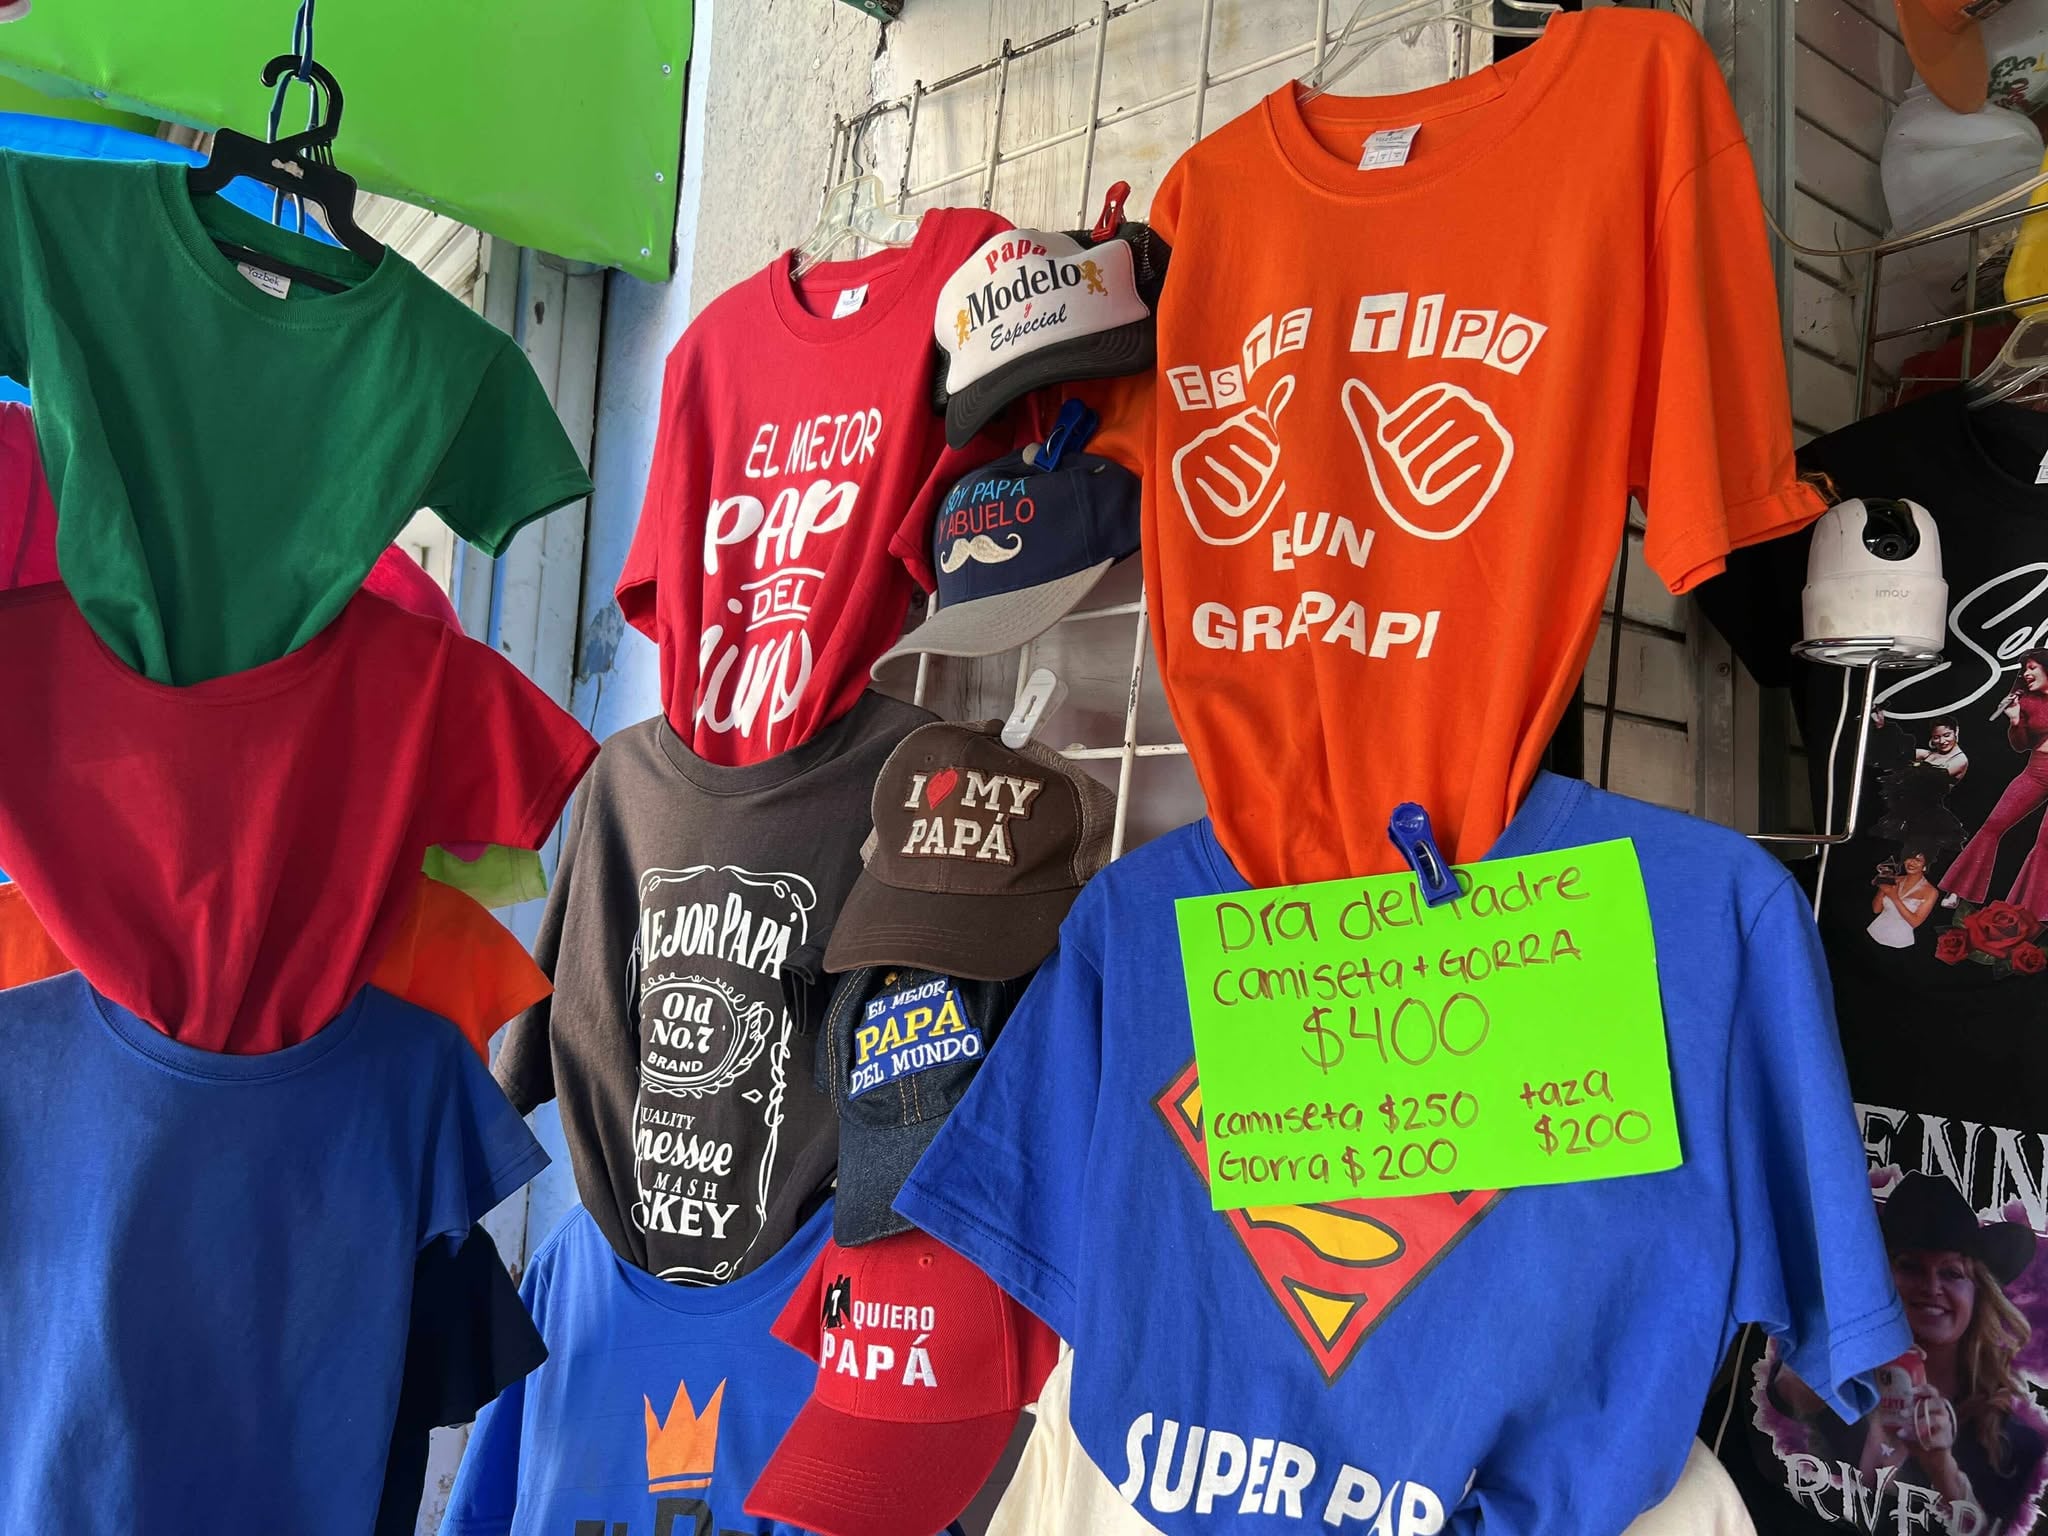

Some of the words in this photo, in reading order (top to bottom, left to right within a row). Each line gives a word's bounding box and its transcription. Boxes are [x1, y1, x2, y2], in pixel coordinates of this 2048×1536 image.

[247, 266, 280, 287] Yazbek
[966, 259, 1081, 333] Modelo
[990, 303, 1068, 351] Especial
[1023, 302, 1033, 318] y
[1166, 307, 1312, 411] ESTE
[1350, 292, 1548, 375] TIPO
[745, 423, 780, 479] EL
[785, 407, 883, 474] MEJOR
[703, 479, 860, 576] PAP
[946, 497, 1036, 540] ABUELO
[751, 578, 813, 624] DEL
[904, 774, 928, 809] I
[960, 770, 1040, 815] MY
[901, 812, 1011, 862] PAPÁ
[1338, 881, 1425, 941] del
[1438, 928, 1582, 984] GORRA
[662, 992, 714, 1025] Old
[867, 1000, 887, 1020] EL
[889, 979, 946, 1010] MEJOR
[856, 990, 967, 1066] PAPÁ
[1301, 991, 1491, 1075] $400
[647, 1051, 704, 1073] BRAND
[851, 1062, 885, 1095] DEL
[890, 1034, 979, 1077] MUNDO
[1519, 1068, 1615, 1110] taza
[640, 1106, 697, 1130] UALITY
[1213, 1101, 1364, 1139] camiseta
[1378, 1090, 1480, 1134] $250
[1533, 1108, 1652, 1156] $200
[653, 1171, 719, 1200] MASH
[1217, 1153, 1329, 1185] Gorra
[852, 1299, 936, 1331] QUIERO
[820, 1333, 938, 1388] PAPÁ
[1118, 1411, 1316, 1519] SUPER
[1323, 1464, 1477, 1536] PAP
